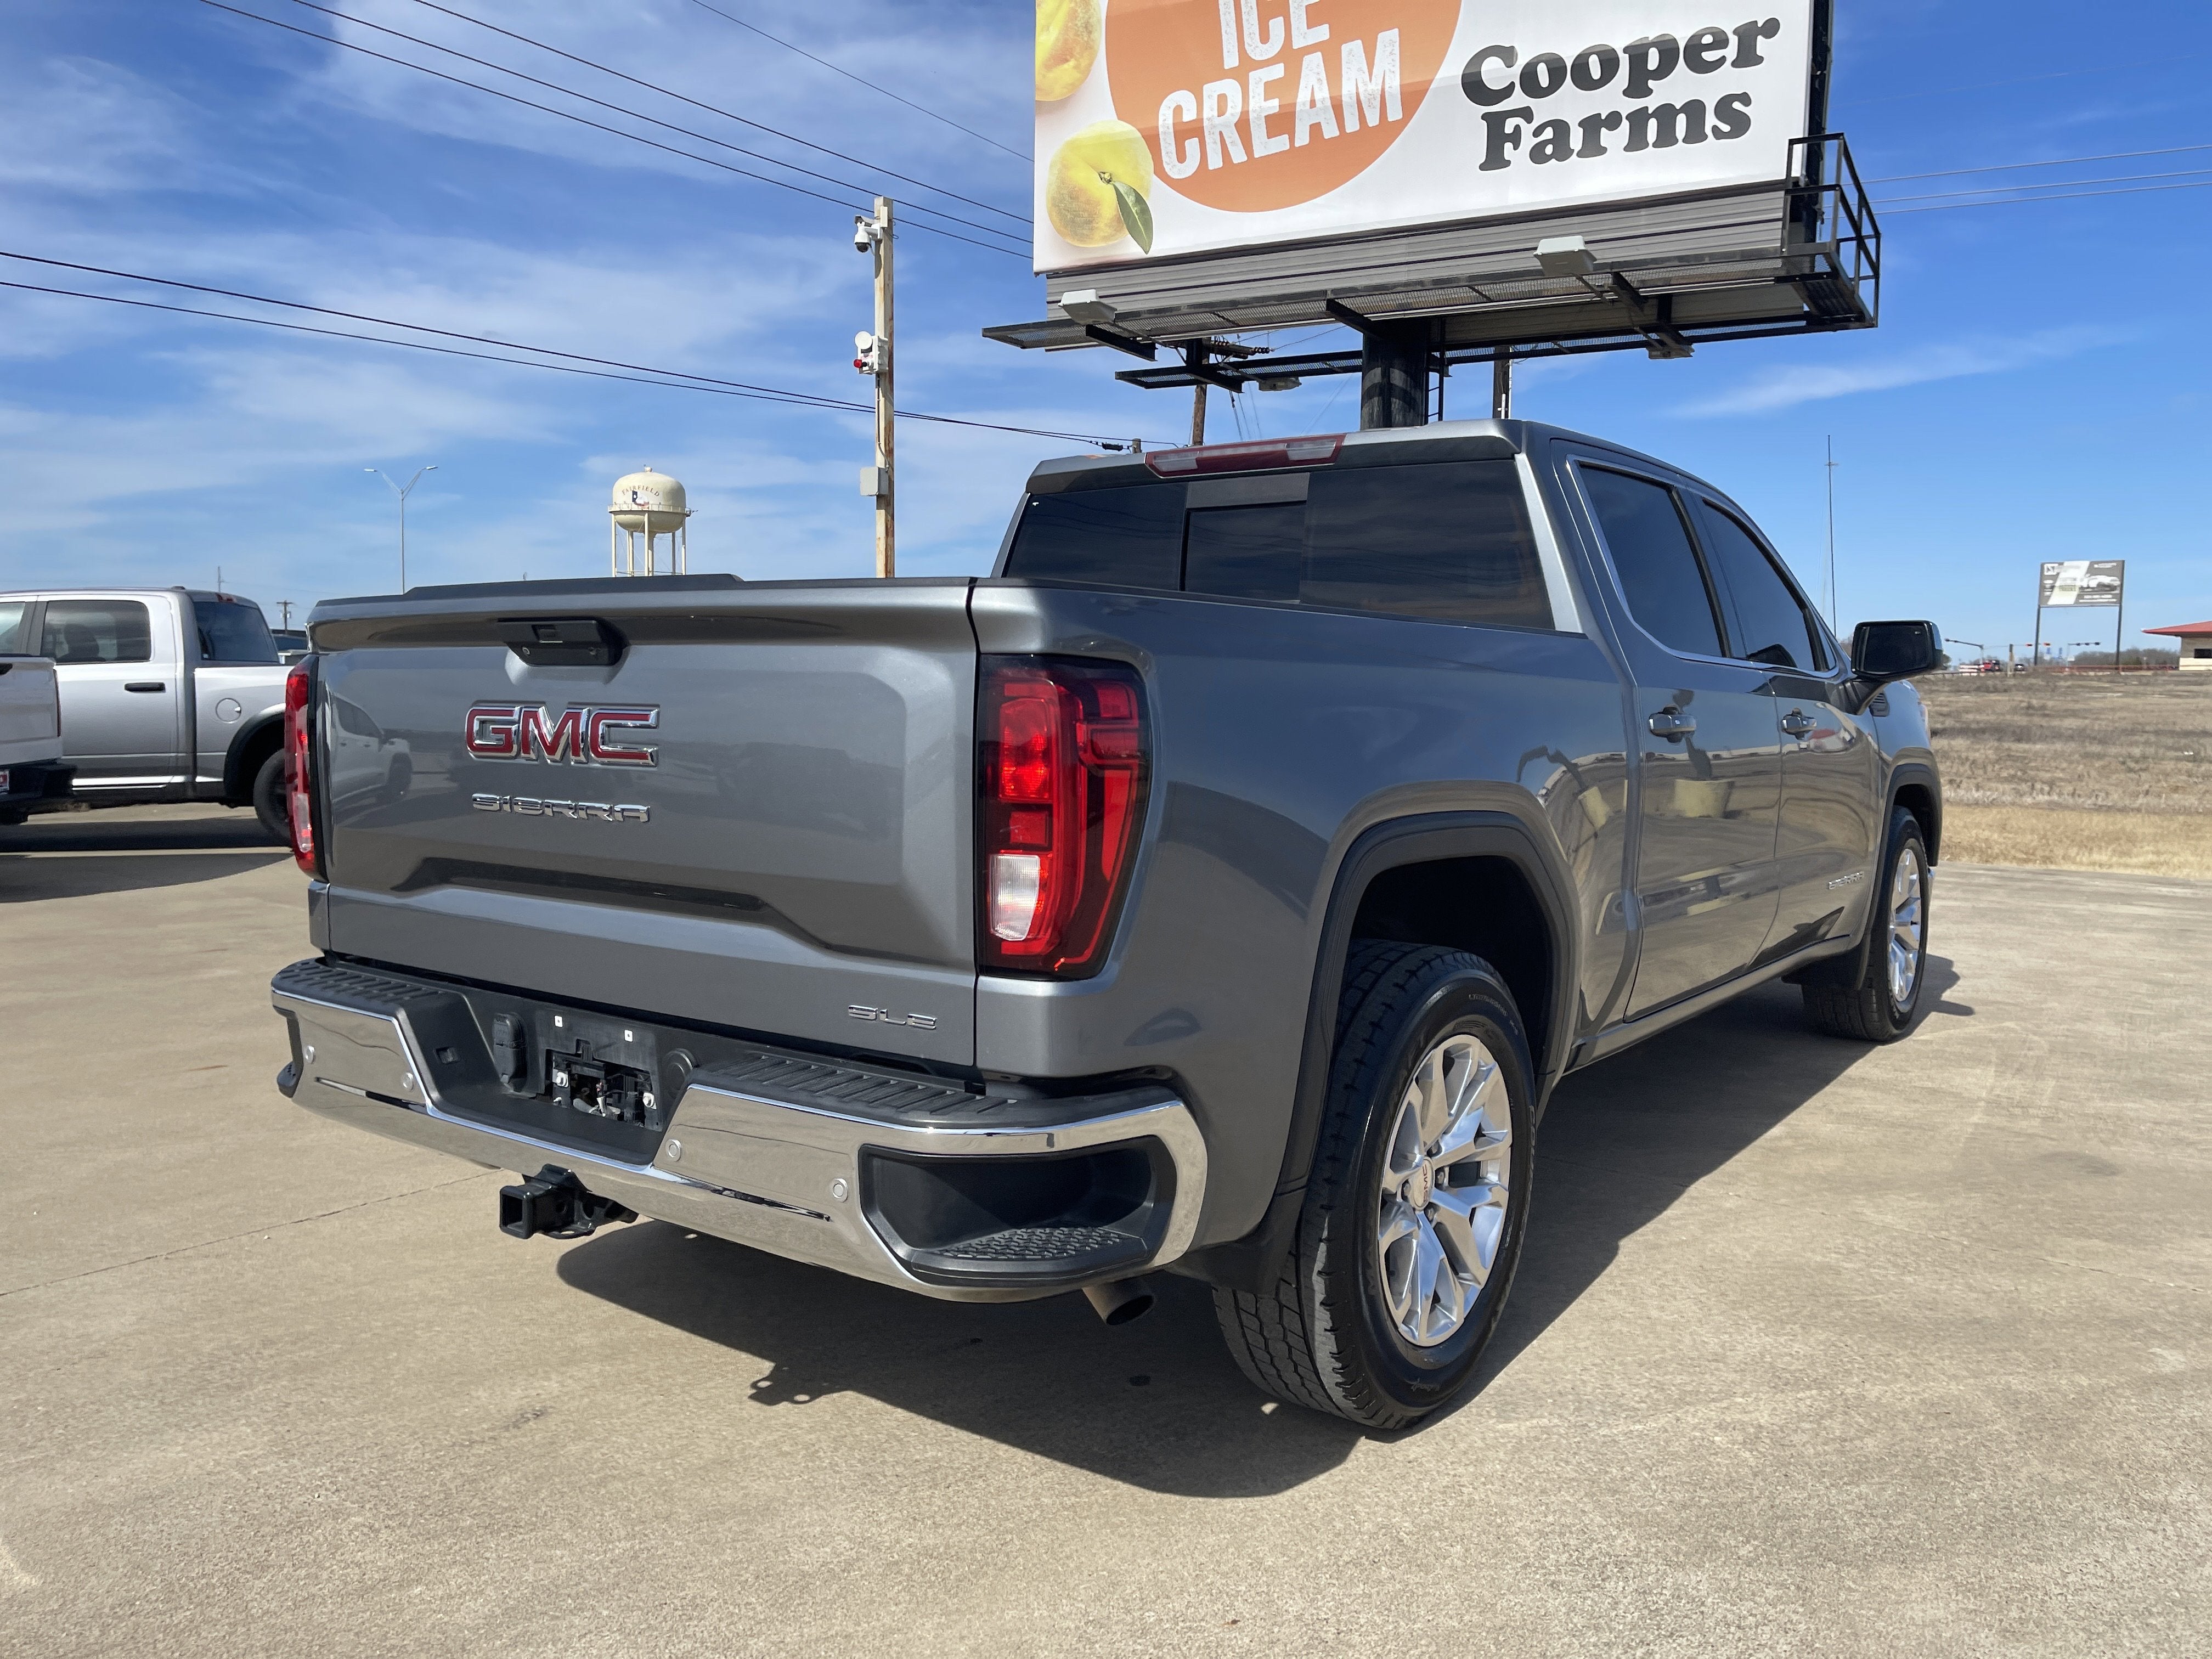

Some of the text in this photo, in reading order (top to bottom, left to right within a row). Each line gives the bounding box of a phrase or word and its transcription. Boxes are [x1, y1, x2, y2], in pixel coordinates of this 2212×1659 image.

[1220, 0, 1330, 70] ICE
[1460, 17, 1780, 106] Cooper
[1158, 28, 1403, 180] CREAM
[1478, 92, 1752, 173] Farms
[622, 485, 660, 496] FAIRFIELD
[465, 706, 659, 768] GMC
[472, 793, 651, 823] SIERRA
[1829, 871, 1864, 890] SIERRA
[848, 1005, 937, 1030] SLE
